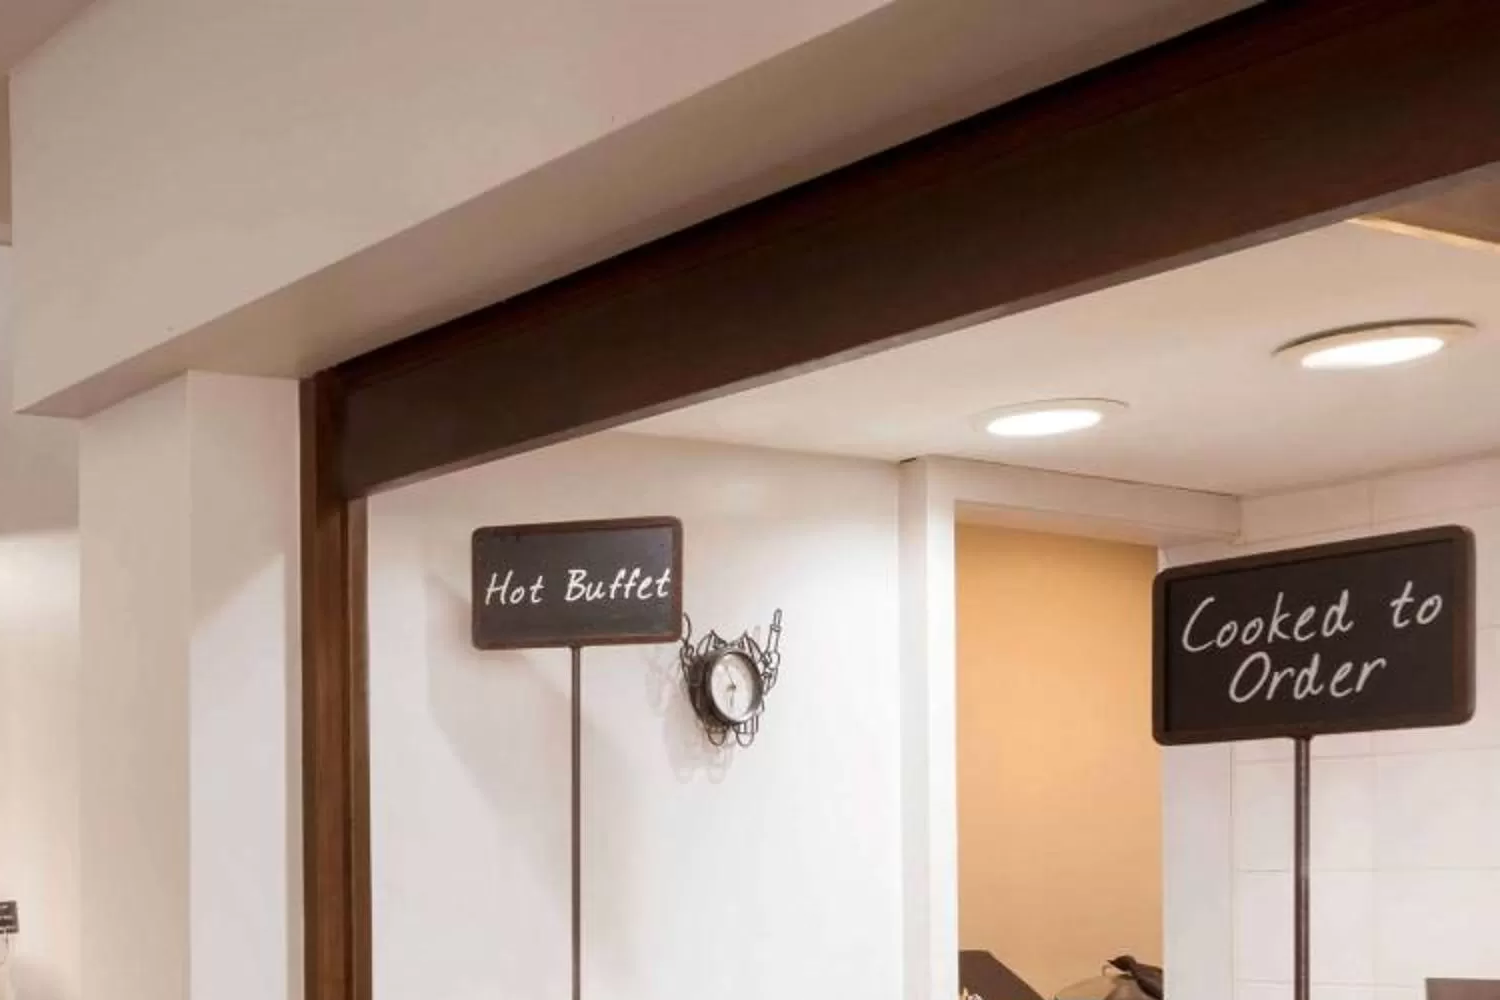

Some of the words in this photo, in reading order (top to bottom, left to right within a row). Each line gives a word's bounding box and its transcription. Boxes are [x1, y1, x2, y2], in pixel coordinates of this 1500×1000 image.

[484, 569, 545, 606] Hot
[564, 568, 671, 601] Buffet
[1182, 589, 1354, 651] Cooked
[1390, 580, 1443, 628] to
[1229, 651, 1387, 702] Order
